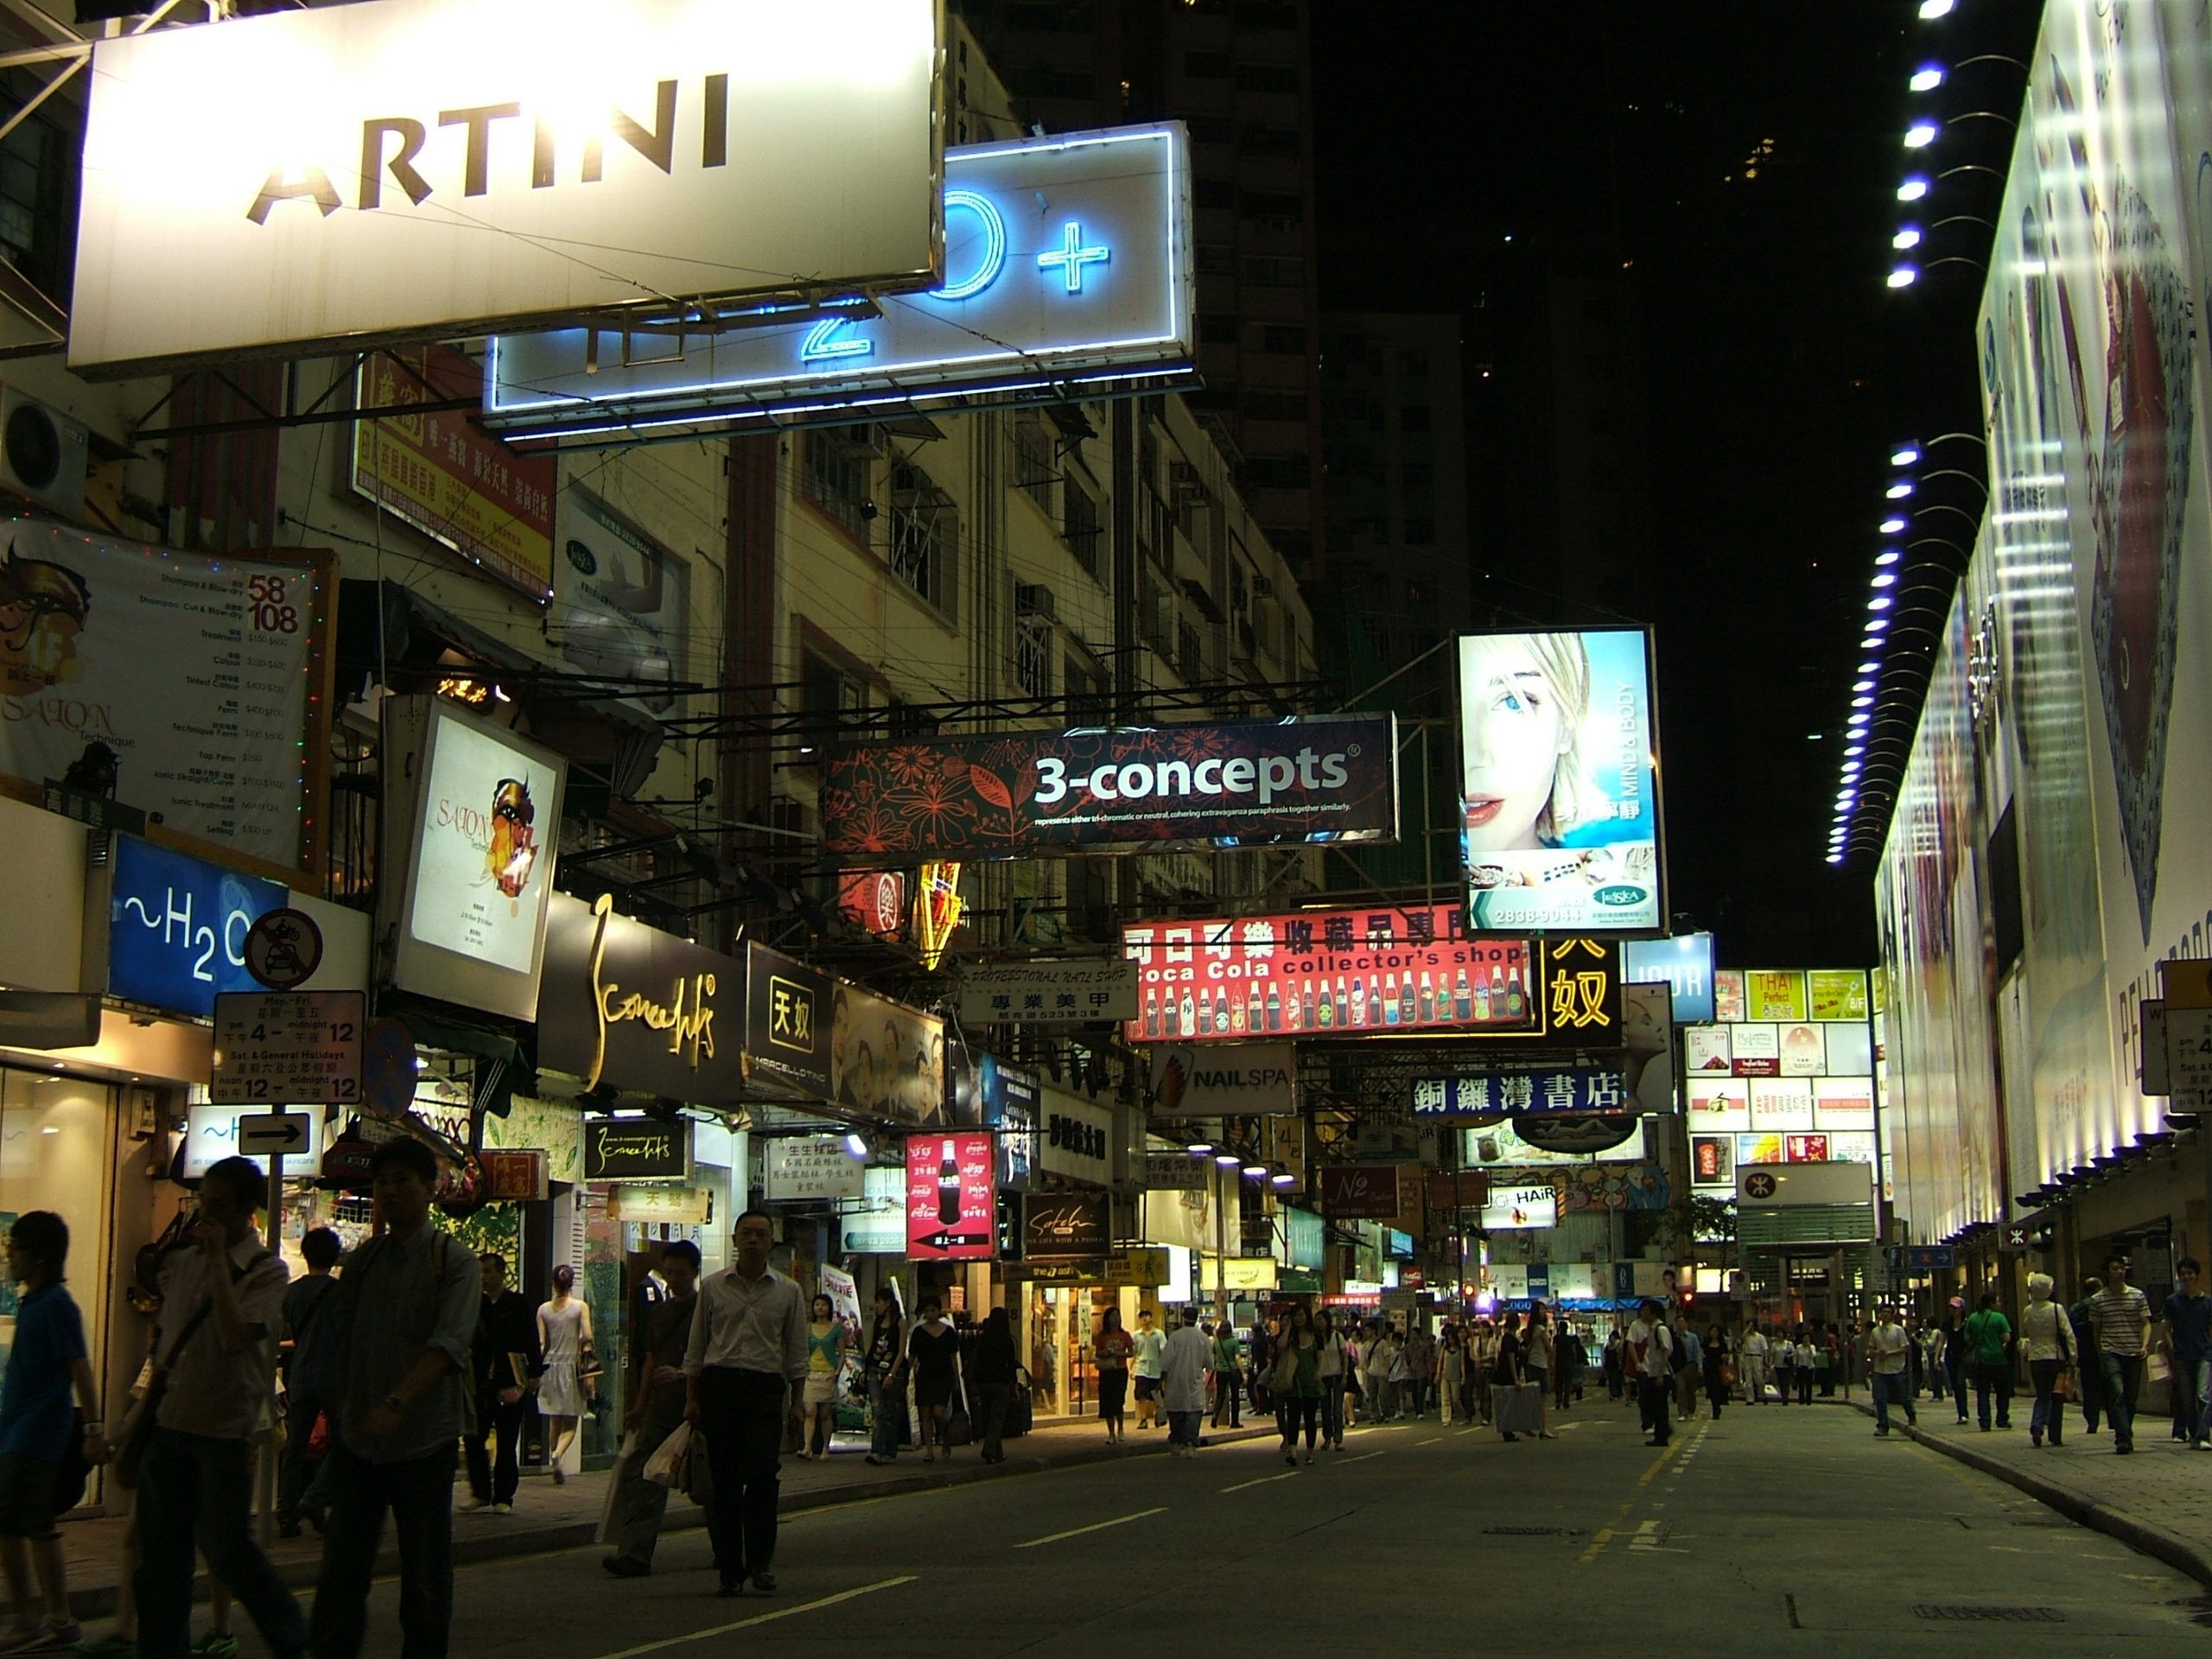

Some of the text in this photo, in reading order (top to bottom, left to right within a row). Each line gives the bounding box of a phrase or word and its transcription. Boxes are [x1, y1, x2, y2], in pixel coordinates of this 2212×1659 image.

[245, 73, 728, 226] ARTINI
[248, 574, 286, 604] 58
[248, 603, 299, 633] 108
[201, 629, 242, 643] Treatment
[213, 656, 241, 666] Colour
[186, 676, 211, 688] Tinted
[213, 680, 240, 690] Colour
[172, 722, 215, 736] Technique
[200, 751, 214, 760] Top
[1034, 815, 1071, 826] represents
[1071, 814, 1091, 824] either
[1091, 811, 1135, 824] tri-chromatic
[1135, 812, 1143, 821] or
[1170, 808, 1201, 821] cohering
[1202, 806, 1248, 818] extravaganza
[1248, 804, 1288, 817] paraphrasis
[1288, 804, 1319, 815] together
[1494, 908, 1582, 925] 2838-9044
[1207, 959, 1270, 980] Cola
[1282, 950, 1440, 975] collector's
[1454, 945, 1522, 965] shop
[971, 969, 1058, 983] PROFESSIONAL
[1096, 969, 1128, 982] SHOP
[1756, 973, 1793, 991] THAI
[991, 992, 1109, 1010] 專業美甲
[1764, 992, 1789, 1002] Perfect
[257, 1007, 320, 1020] 星期一至五
[774, 990, 811, 1040] 天奴
[225, 1033, 320, 1045] 下午 午夜
[251, 1024, 267, 1042] 4
[288, 1020, 328, 1030] midnight
[330, 1022, 354, 1042] 12
[261, 1051, 299, 1060] General
[302, 1051, 346, 1061] Holidays
[218, 1087, 322, 1099] 中午 午夜
[245, 1079, 269, 1098] 12
[289, 1076, 330, 1085] midnight
[332, 1078, 356, 1098] 12
[1414, 1072, 1621, 1113] 銅鑼灣書店
